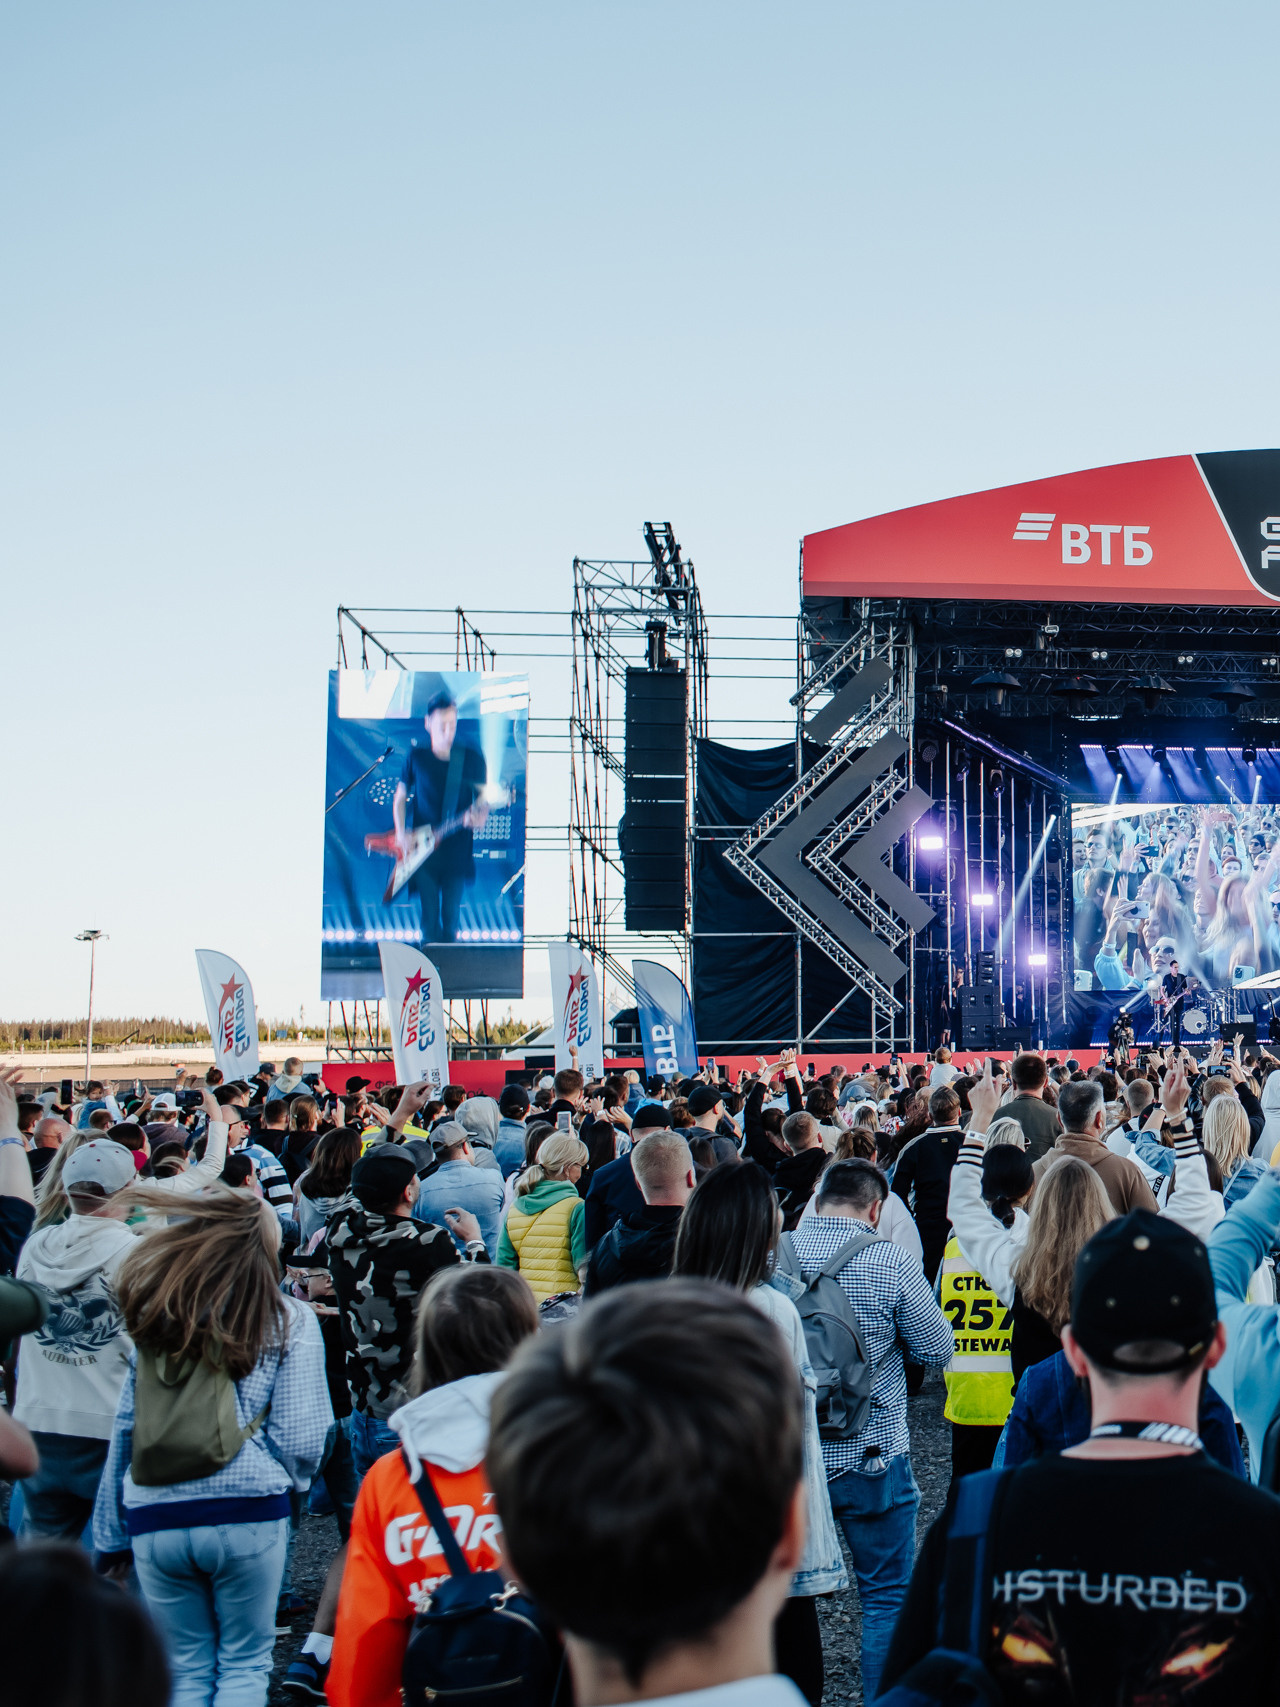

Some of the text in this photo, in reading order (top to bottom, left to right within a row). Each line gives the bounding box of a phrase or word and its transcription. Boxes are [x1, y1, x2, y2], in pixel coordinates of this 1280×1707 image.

[1061, 523, 1153, 566] ВТБ
[944, 1298, 1014, 1331] 257
[992, 1569, 1249, 1614] ISTURBED
